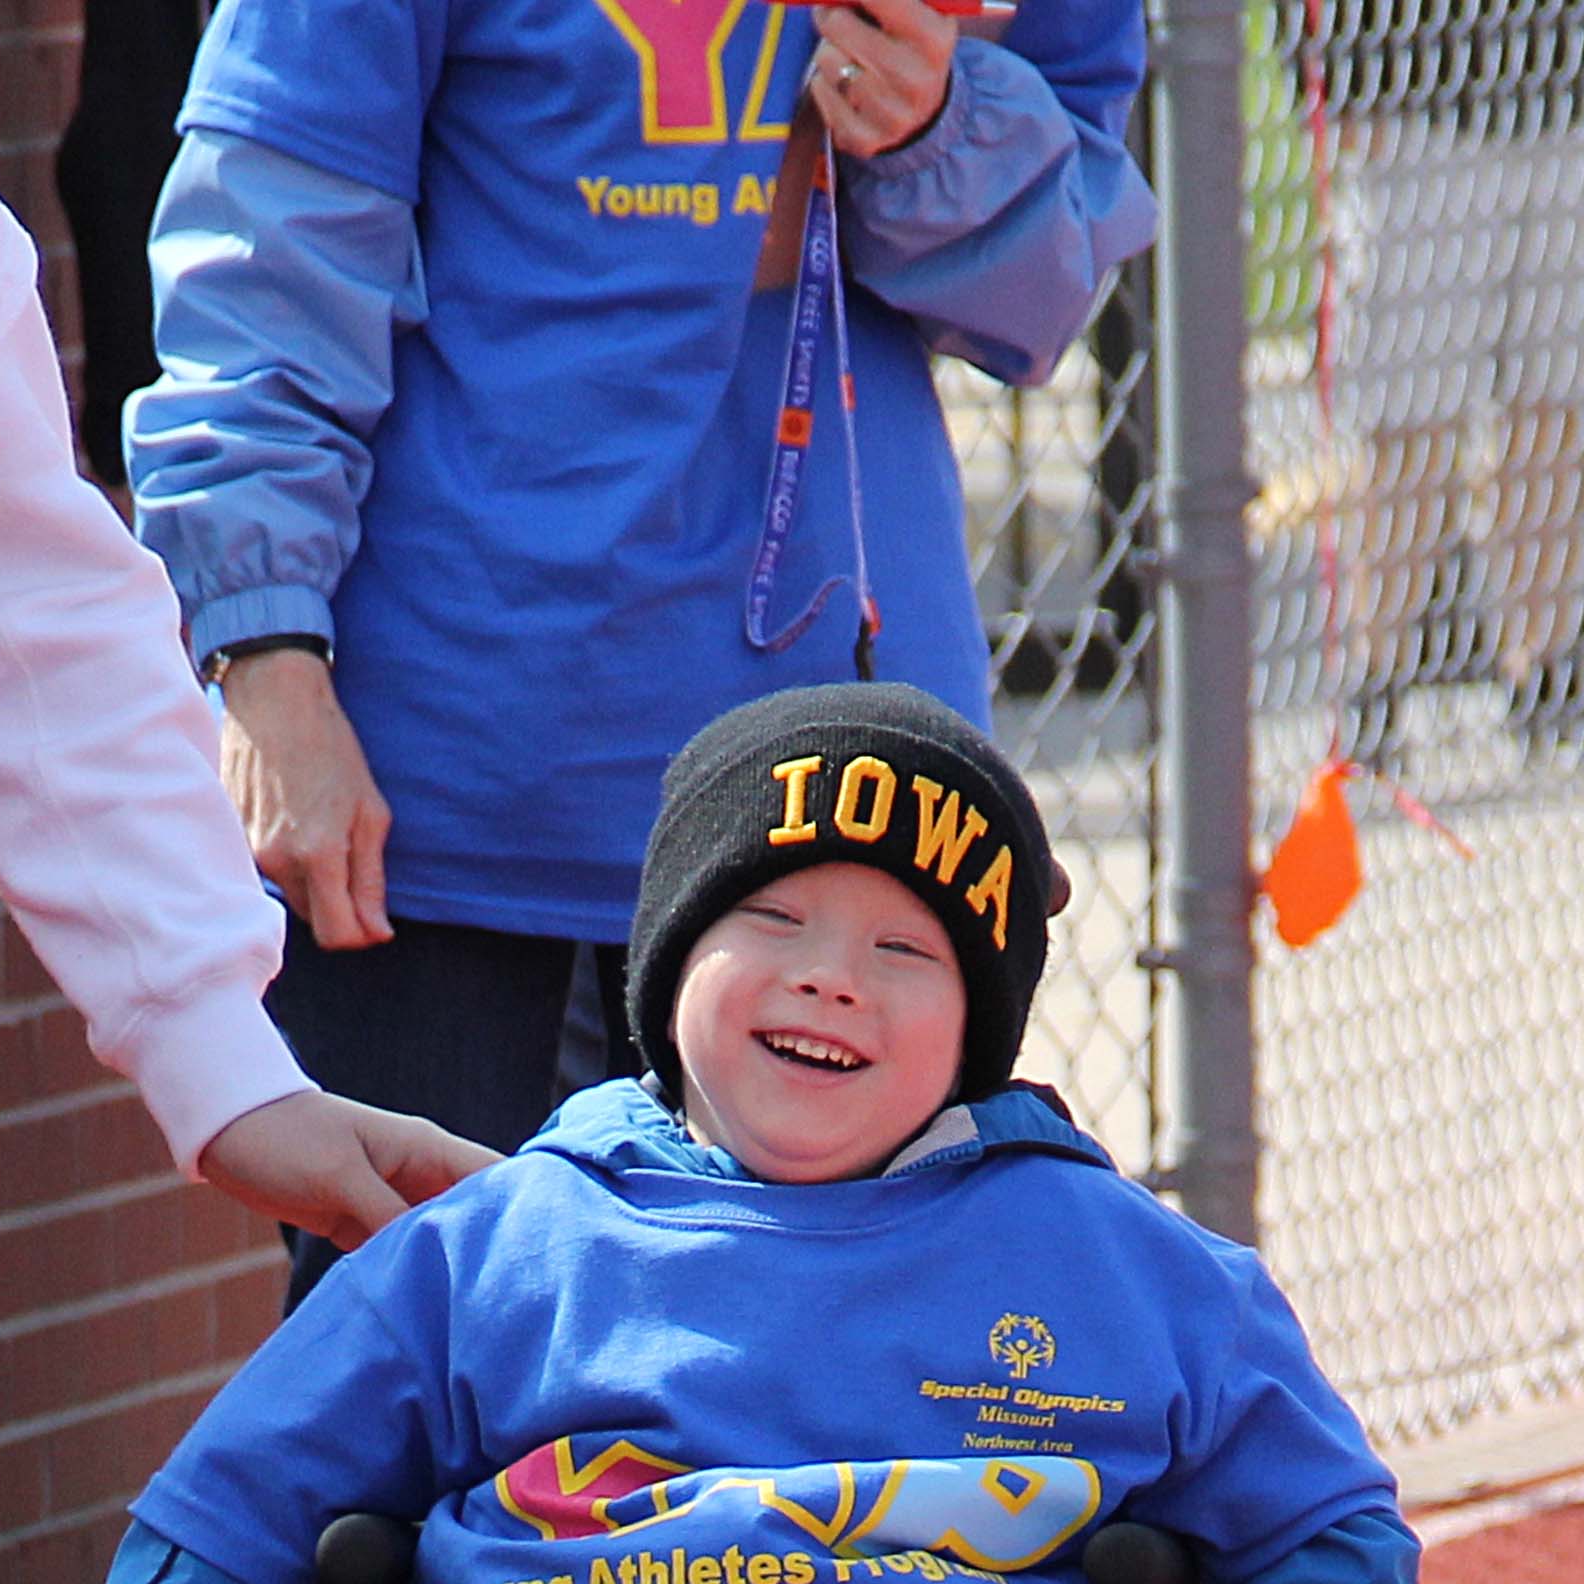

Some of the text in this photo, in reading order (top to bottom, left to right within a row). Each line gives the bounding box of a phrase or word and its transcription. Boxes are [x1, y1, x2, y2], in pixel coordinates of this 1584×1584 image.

[576, 175, 720, 226] Young
[768, 754, 1013, 951] IOWA
[919, 1379, 1126, 1413] Special Olympics
[976, 1405, 1056, 1428] Missouri
[962, 1432, 1074, 1453] Northwest Area
